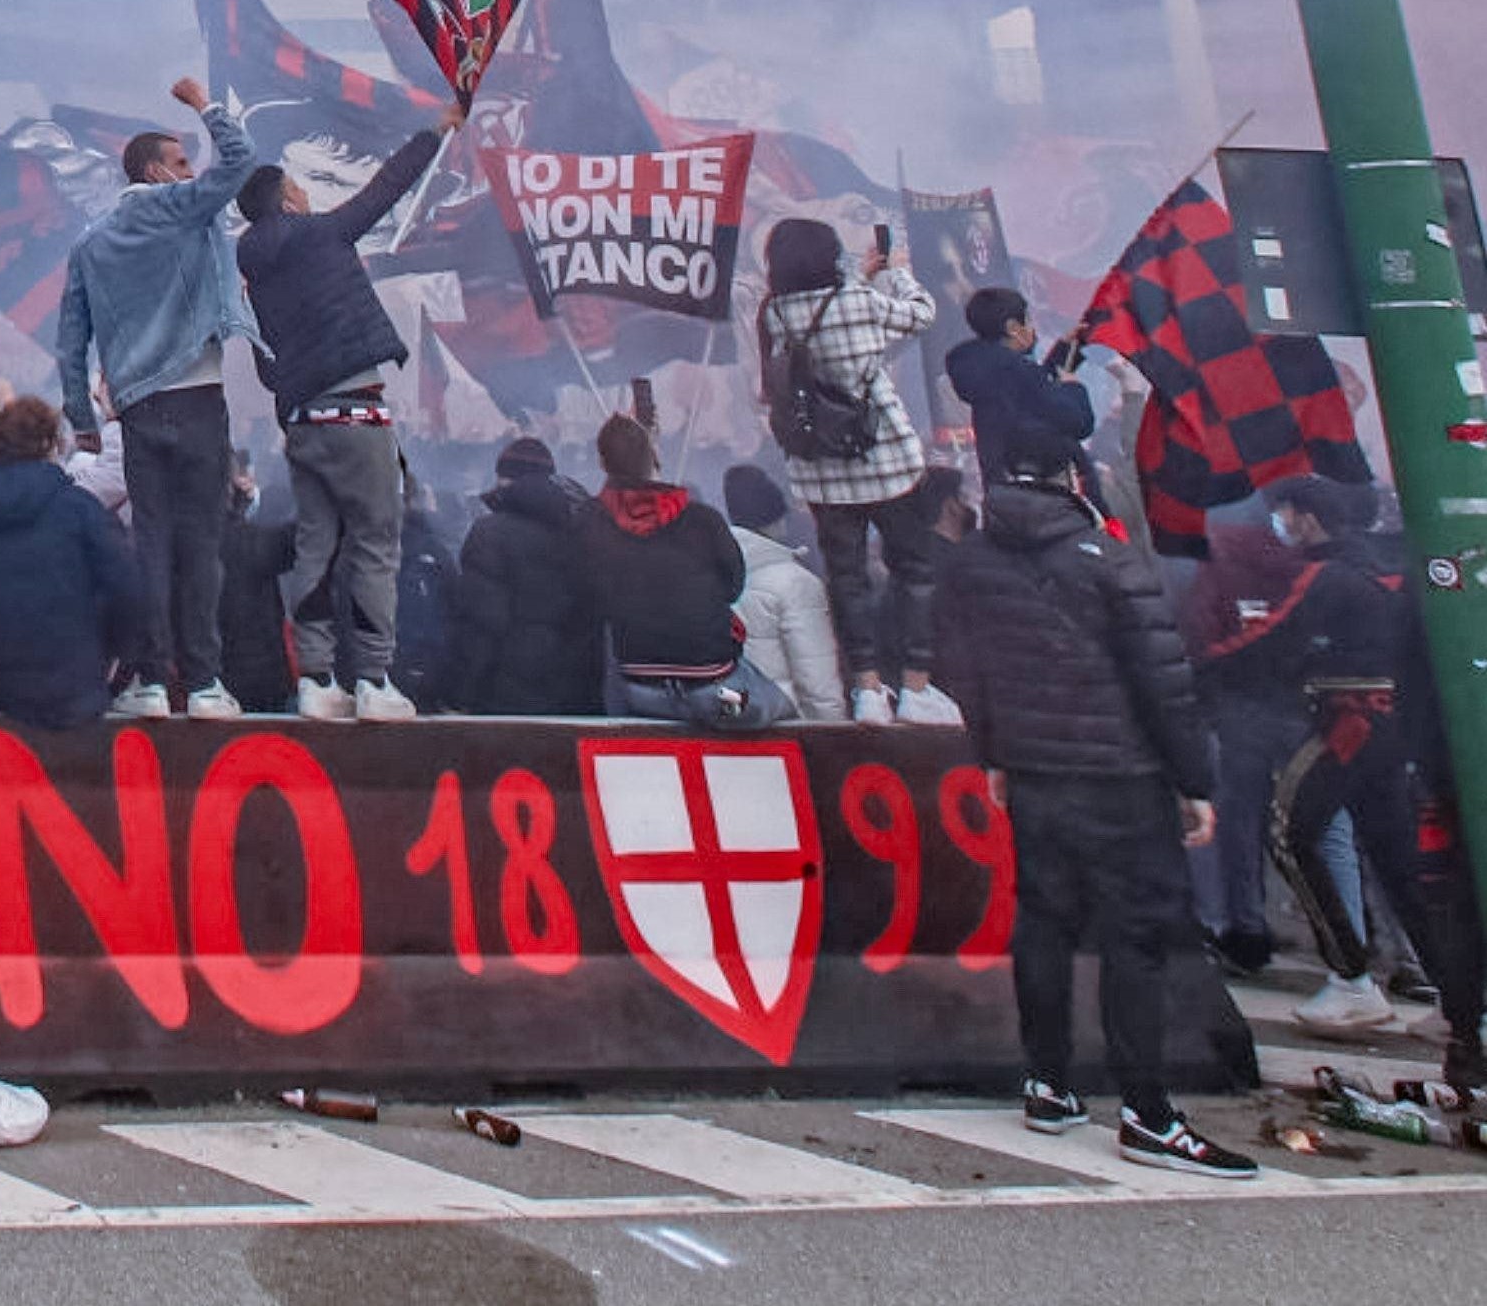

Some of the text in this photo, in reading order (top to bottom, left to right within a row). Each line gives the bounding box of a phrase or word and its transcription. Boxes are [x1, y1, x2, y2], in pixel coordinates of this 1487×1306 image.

[506, 146, 725, 196] IO DI TE
[518, 193, 717, 245] NON MI
[405, 768, 583, 976] 18
[840, 762, 1019, 974] 99
